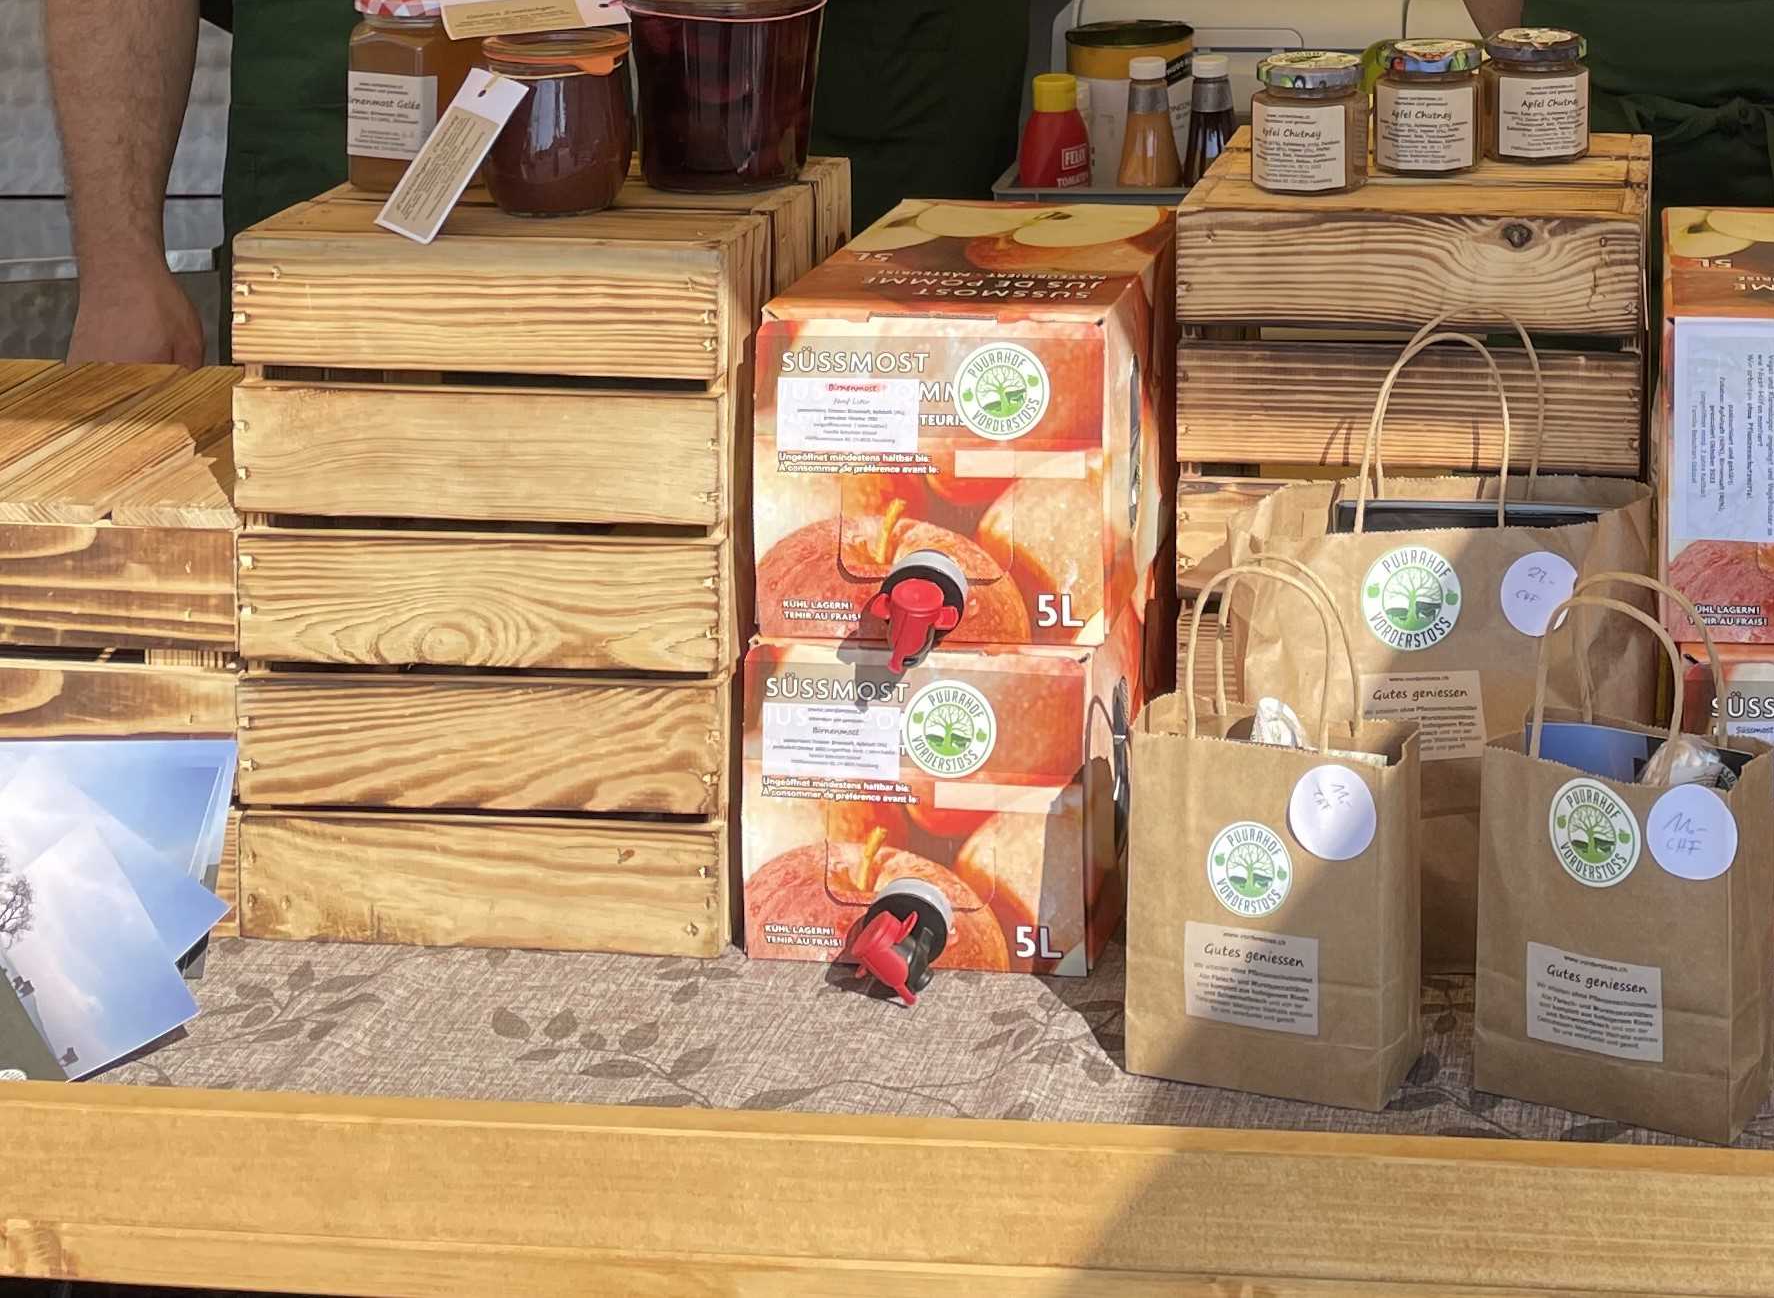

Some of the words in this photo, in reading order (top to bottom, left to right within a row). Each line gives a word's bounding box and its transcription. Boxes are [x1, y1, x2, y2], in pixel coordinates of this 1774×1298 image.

[1546, 98, 1578, 108] Chutne
[781, 346, 930, 374] SÜSSMOST
[971, 398, 1041, 433] VORDERSTOSS
[1037, 593, 1086, 628] 5L
[1370, 612, 1453, 649] VORDERSTOSS
[765, 672, 910, 702] SÜSSMOST
[1373, 688, 1407, 701] Gutes
[1412, 689, 1468, 702] geniessen
[911, 735, 979, 773] VORDERSTOSS
[1560, 840, 1628, 880] VORDERSTOSS
[1216, 876, 1283, 915] VORDERSTOSS
[1015, 925, 1064, 960] 5L
[1204, 942, 1241, 959] Gutes
[1244, 950, 1305, 969] geniessen
[1546, 963, 1582, 984] Gutes
[1585, 973, 1648, 995] geniessen
